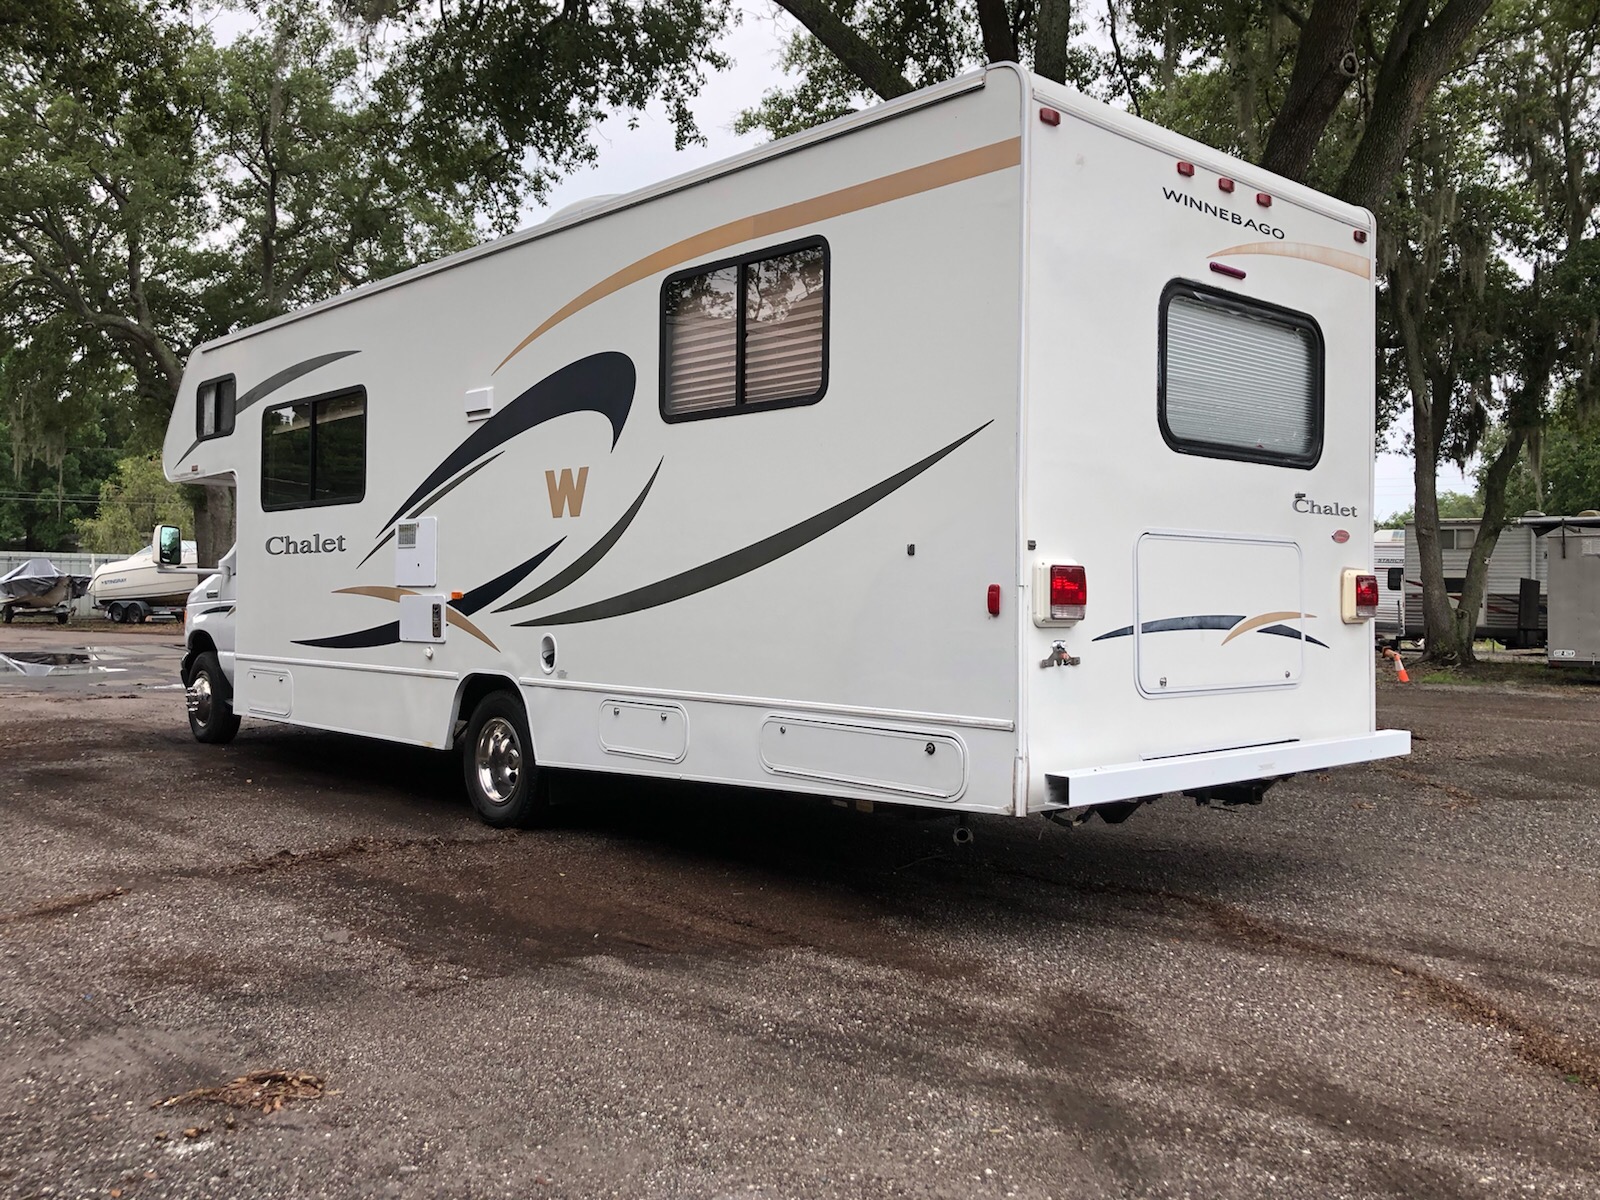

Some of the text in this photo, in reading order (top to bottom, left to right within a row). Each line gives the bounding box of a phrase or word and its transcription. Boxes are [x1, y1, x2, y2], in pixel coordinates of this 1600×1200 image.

[1162, 186, 1286, 240] WINNEBAGO
[545, 466, 589, 518] W
[1292, 498, 1358, 518] Chalet
[265, 533, 347, 555] Chalet
